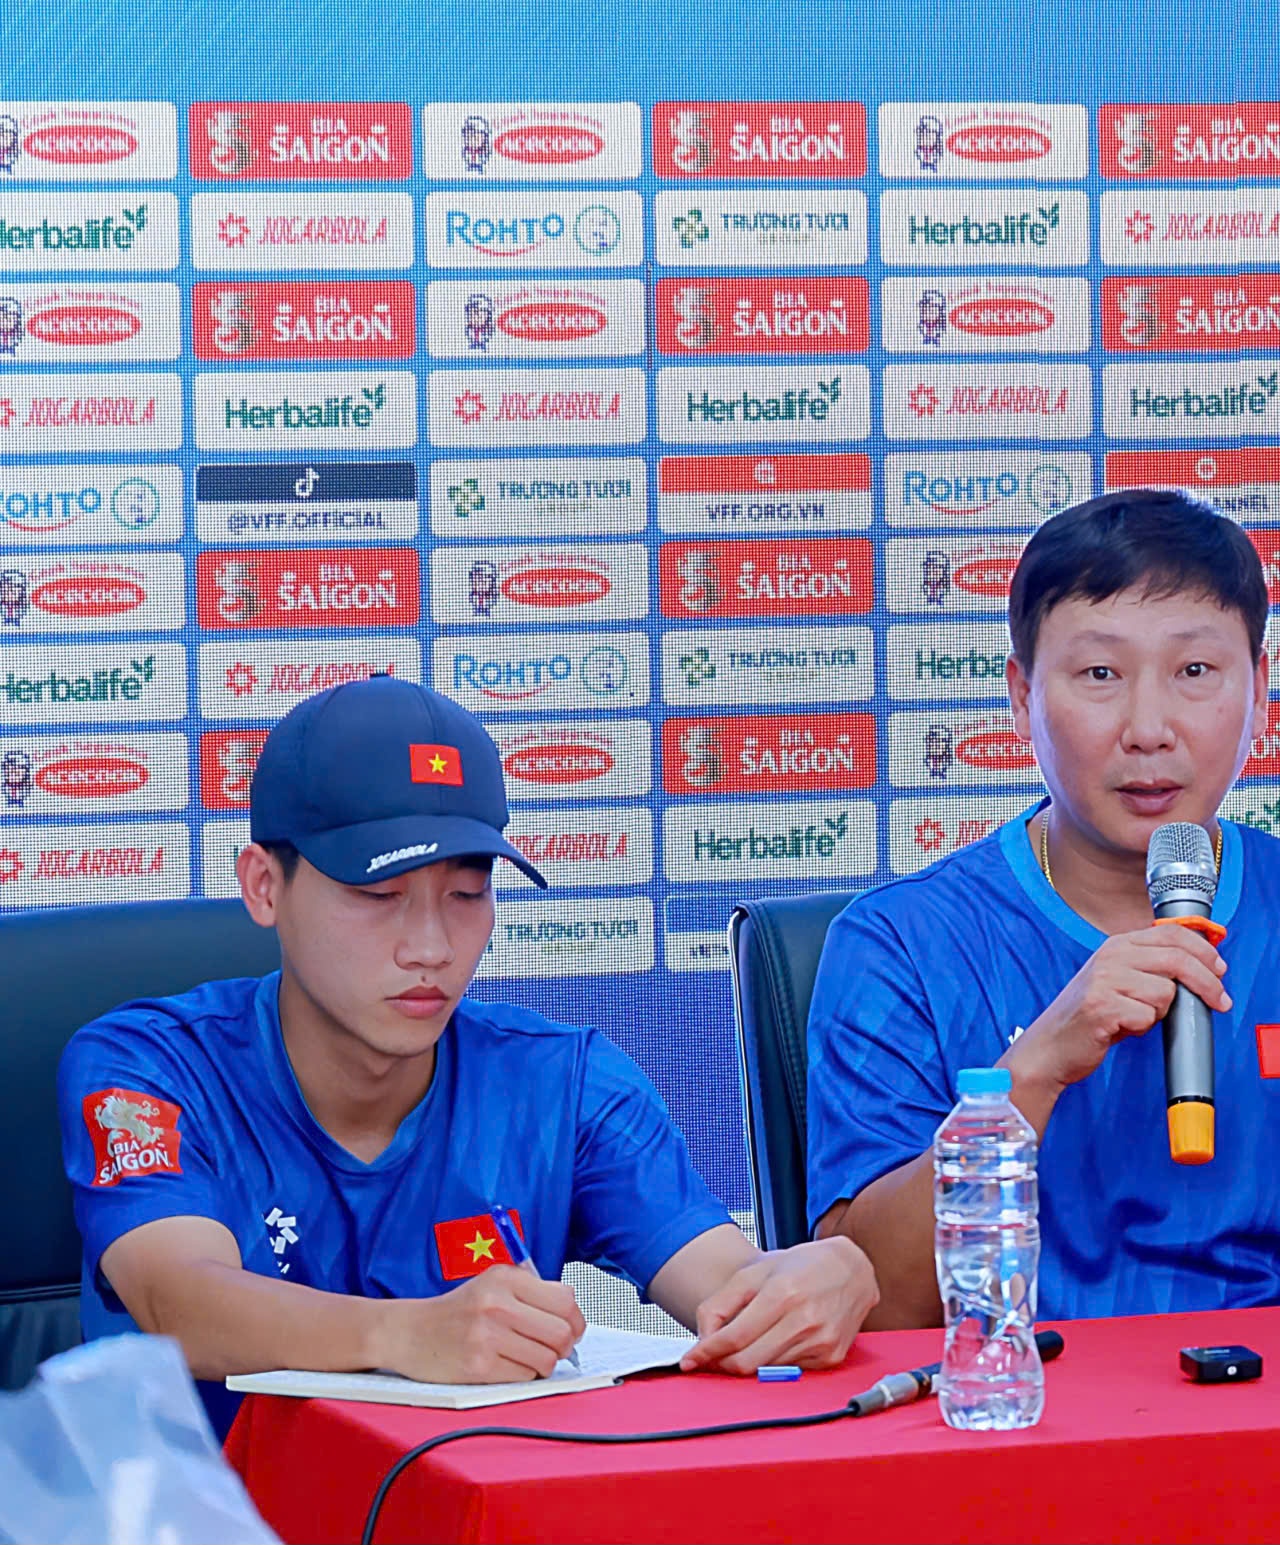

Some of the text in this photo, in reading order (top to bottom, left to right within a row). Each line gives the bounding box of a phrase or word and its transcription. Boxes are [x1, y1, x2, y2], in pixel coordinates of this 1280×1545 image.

[311, 117, 347, 134] BIA
[771, 116, 806, 133] BIA
[1210, 116, 1244, 133] BIA
[270, 135, 389, 163] SAIGON
[731, 135, 847, 162] SAIGON
[446, 210, 566, 246] ROHTO
[908, 213, 1048, 246] Herbalife
[314, 296, 350, 313] BIA
[774, 292, 809, 309] BIA
[1213, 289, 1246, 306] BIA
[273, 314, 393, 342] SAIGON
[734, 310, 850, 338] SAIGON
[224, 395, 372, 429] Herbalife
[687, 389, 829, 423] Herbalife
[1130, 384, 1266, 417] Herbalife
[904, 469, 1019, 504] ROHTO
[0, 485, 101, 520] OHTO
[318, 564, 354, 581] BIA
[778, 554, 812, 572] BIA
[277, 581, 397, 611] SAIGON
[738, 571, 853, 600] SAIGON
[453, 652, 573, 690] ROHTO
[915, 646, 1006, 681] Herba
[780, 729, 814, 746] BIA
[740, 745, 855, 775] SAIGON
[692, 824, 835, 861] Herbalife
[113, 1140, 140, 1156] BIA
[99, 1147, 171, 1185] SAIGON
